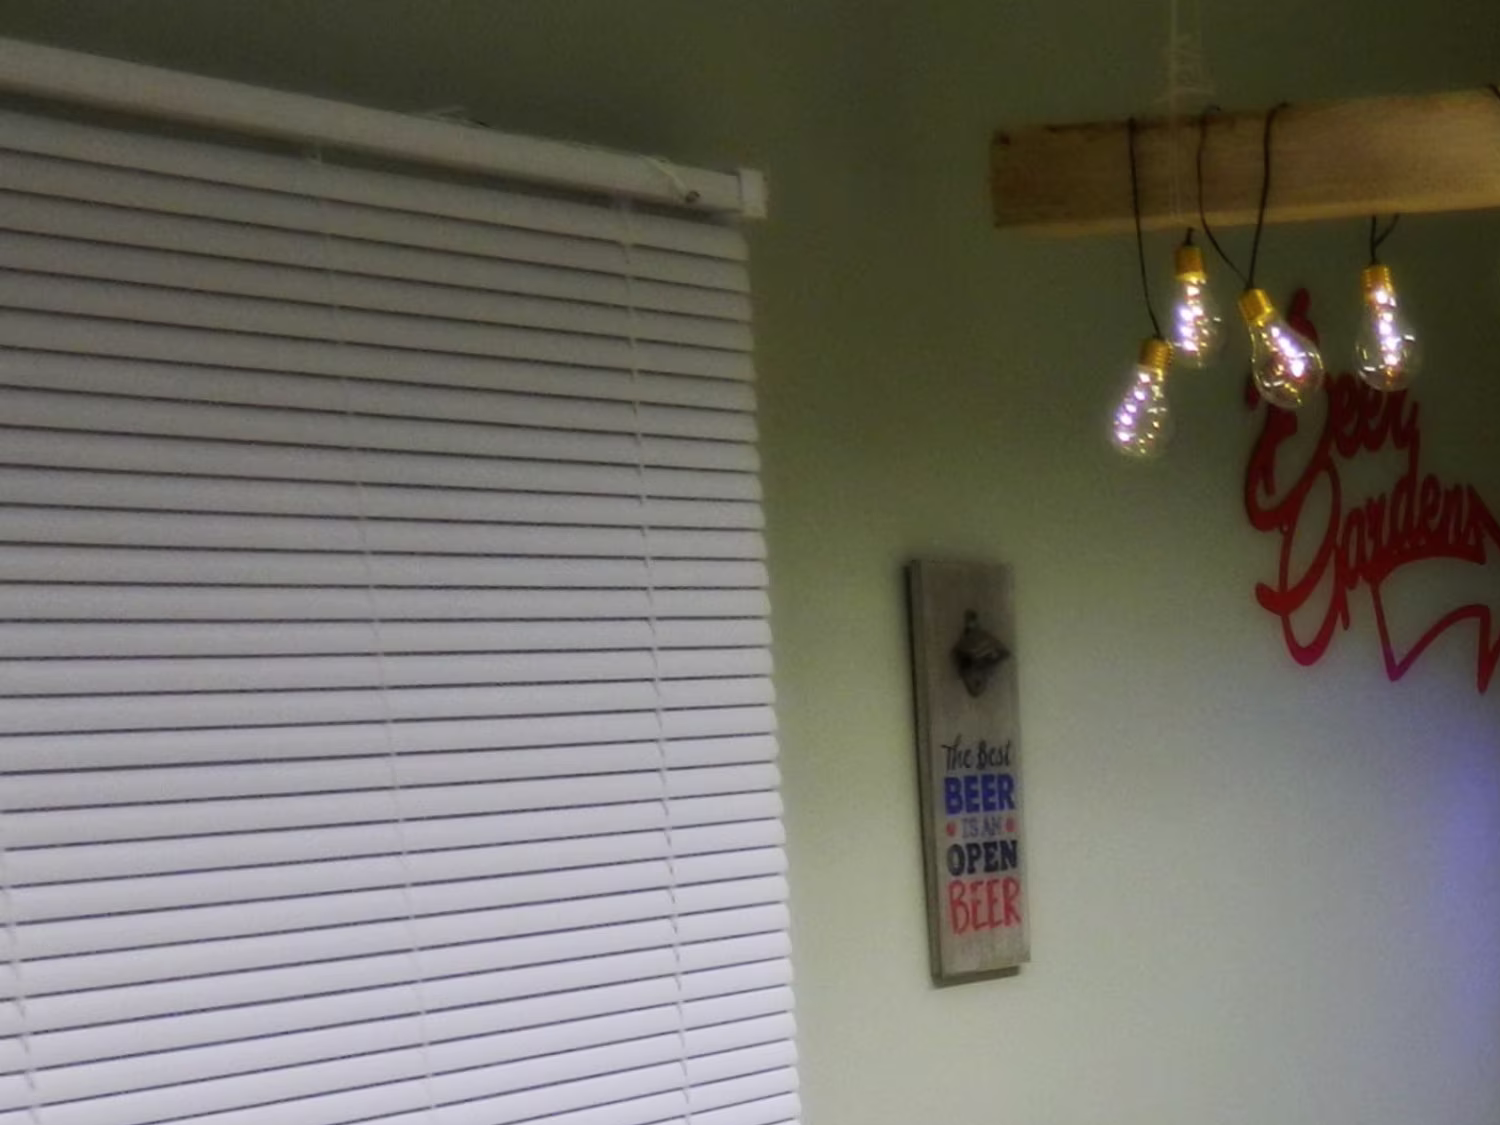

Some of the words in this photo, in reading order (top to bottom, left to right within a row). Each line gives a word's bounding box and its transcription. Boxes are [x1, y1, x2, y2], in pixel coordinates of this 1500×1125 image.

[940, 735, 973, 770] The
[976, 740, 1011, 770] Best
[943, 773, 1016, 816] BEER
[961, 818, 980, 838] IS
[980, 815, 1002, 838] AN
[946, 839, 1019, 877] OPEN
[948, 876, 1022, 935] BEER
